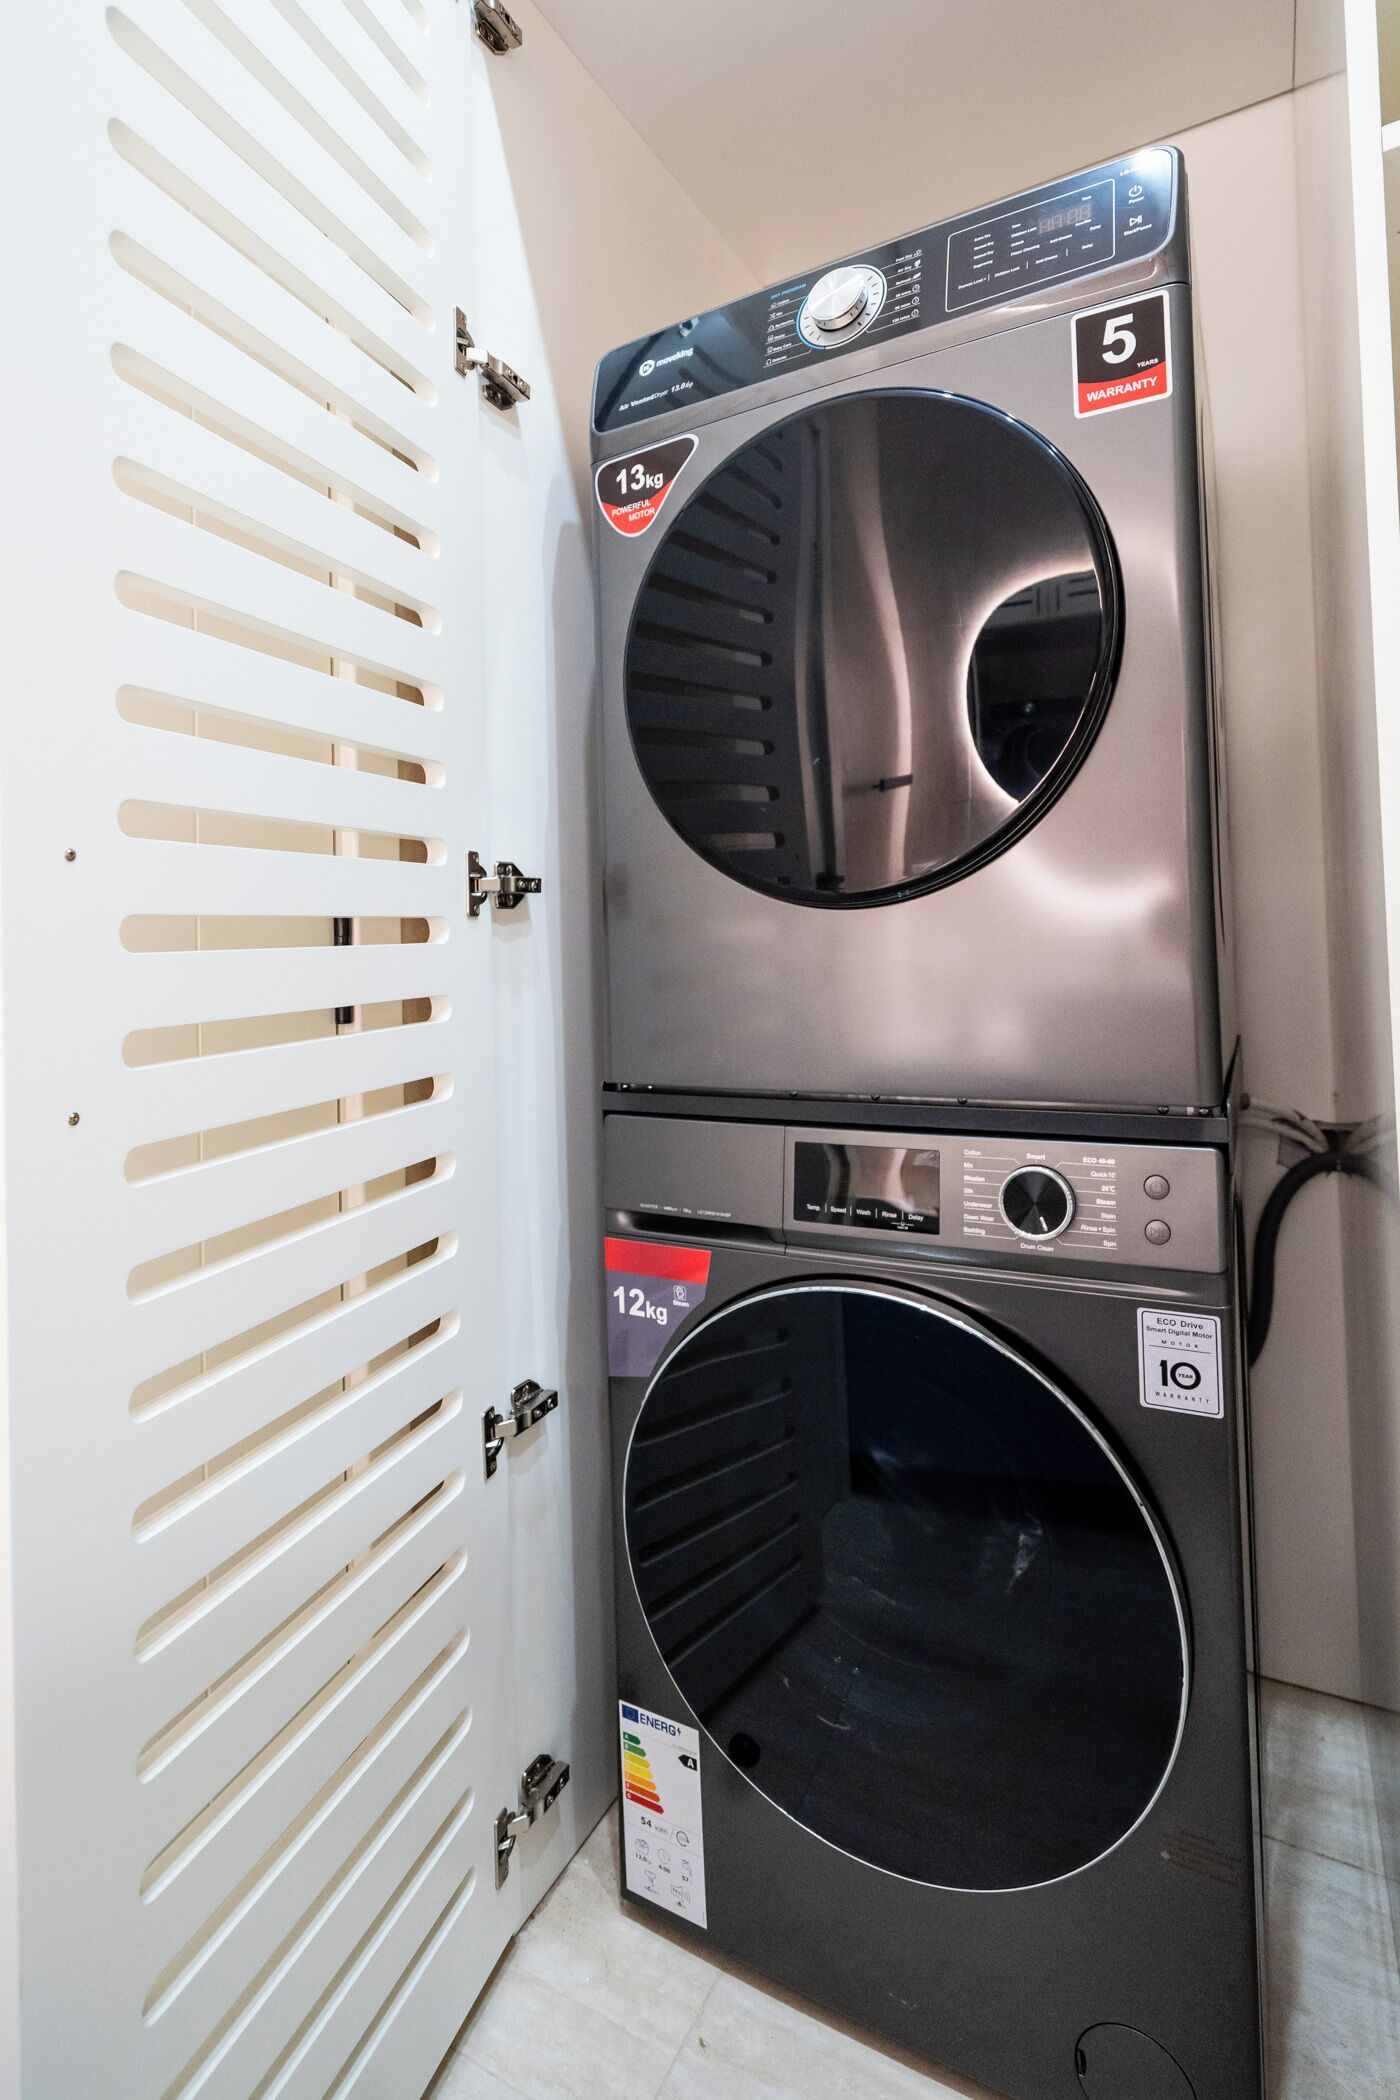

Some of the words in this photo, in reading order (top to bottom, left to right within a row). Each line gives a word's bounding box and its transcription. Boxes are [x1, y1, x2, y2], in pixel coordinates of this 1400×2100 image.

[1101, 312, 1137, 364] 5
[1136, 358, 1159, 368] YEARS
[1086, 376, 1158, 402] WARRANTY
[619, 403, 630, 412] Air
[616, 463, 664, 495] 13kg
[611, 499, 651, 517] POWERFUL
[628, 507, 655, 522] MOTOR
[1026, 1152, 1046, 1161] Smart
[1082, 1156, 1098, 1164] ECO
[1090, 1170, 1107, 1178] Quick
[963, 1200, 993, 1209] Underwear
[1096, 1198, 1116, 1206] Steam
[830, 1206, 847, 1214] Speed
[856, 1208, 871, 1216] Wash
[881, 1211, 897, 1219] Rinse
[908, 1213, 924, 1222] Delay
[963, 1213, 980, 1221] Down
[963, 1226, 986, 1236] Bedding
[1080, 1224, 1098, 1232] Rinse
[1102, 1226, 1116, 1234] Spin
[1020, 1242, 1036, 1250] Drum
[1103, 1240, 1117, 1248] Spin
[613, 1286, 668, 1326] 12kg
[1156, 1317, 1177, 1327] ECO
[1180, 1320, 1204, 1330] Drive
[1146, 1325, 1167, 1334] Smart
[1168, 1328, 1191, 1337] Digital
[1192, 1331, 1213, 1340] Motor
[1160, 1359, 1202, 1390] 10
[1178, 1372, 1194, 1380] YEAR
[1155, 1391, 1210, 1404] WARRANTY
[687, 1758, 695, 1769] A
[640, 1816, 652, 1828] 54
